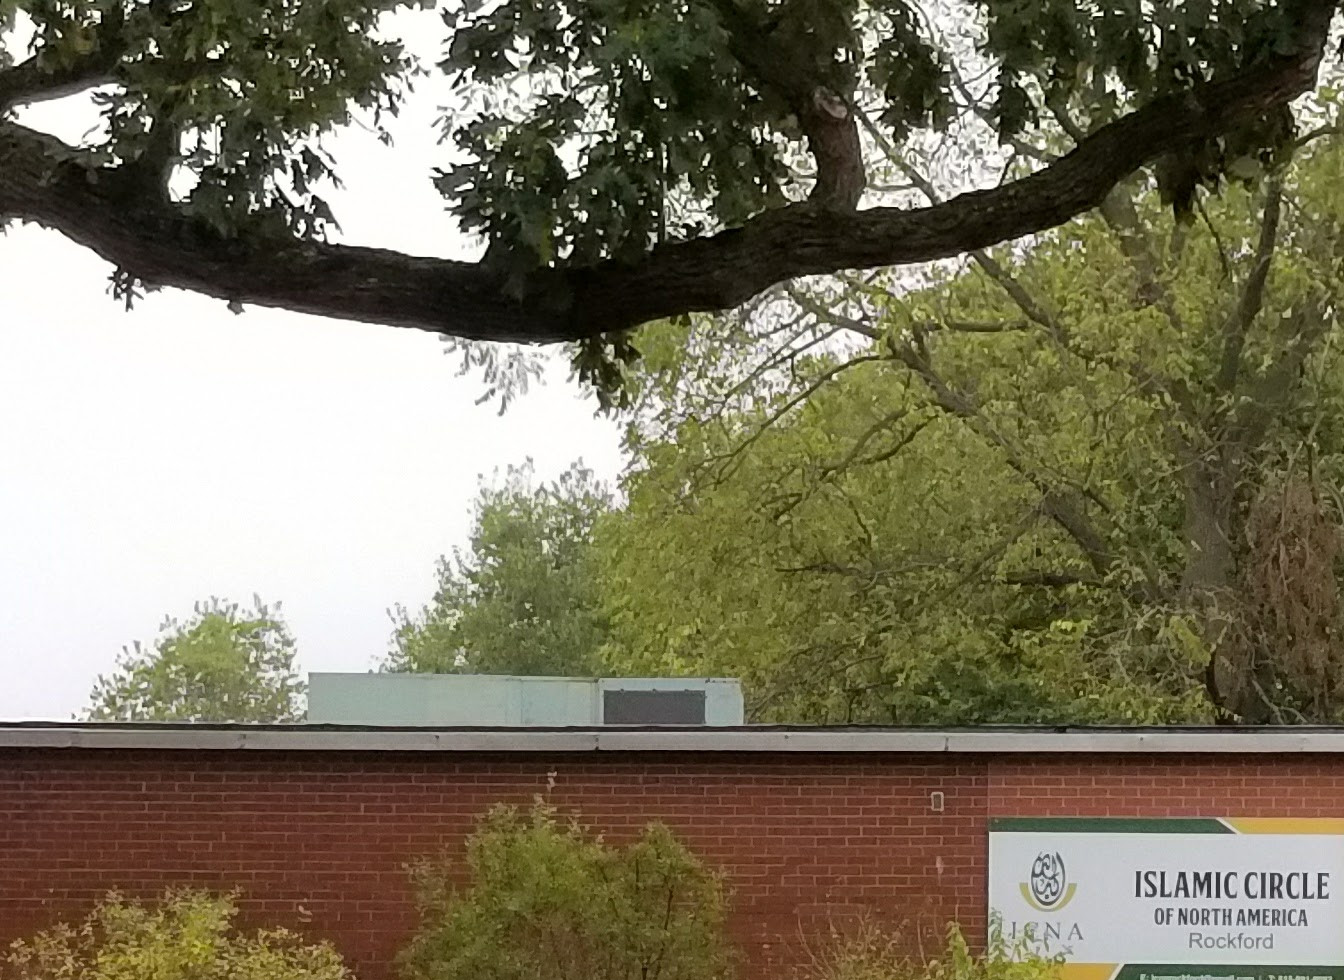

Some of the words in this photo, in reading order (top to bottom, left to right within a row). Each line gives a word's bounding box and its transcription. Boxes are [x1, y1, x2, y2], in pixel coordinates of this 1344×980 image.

[1134, 870, 1238, 899] ISLAMIC
[1243, 871, 1331, 900] CIRCLE
[1154, 907, 1174, 926] OF
[1177, 907, 1233, 926] NORTH
[1235, 908, 1309, 927] AMERICA
[1188, 932, 1274, 950] Rockford
